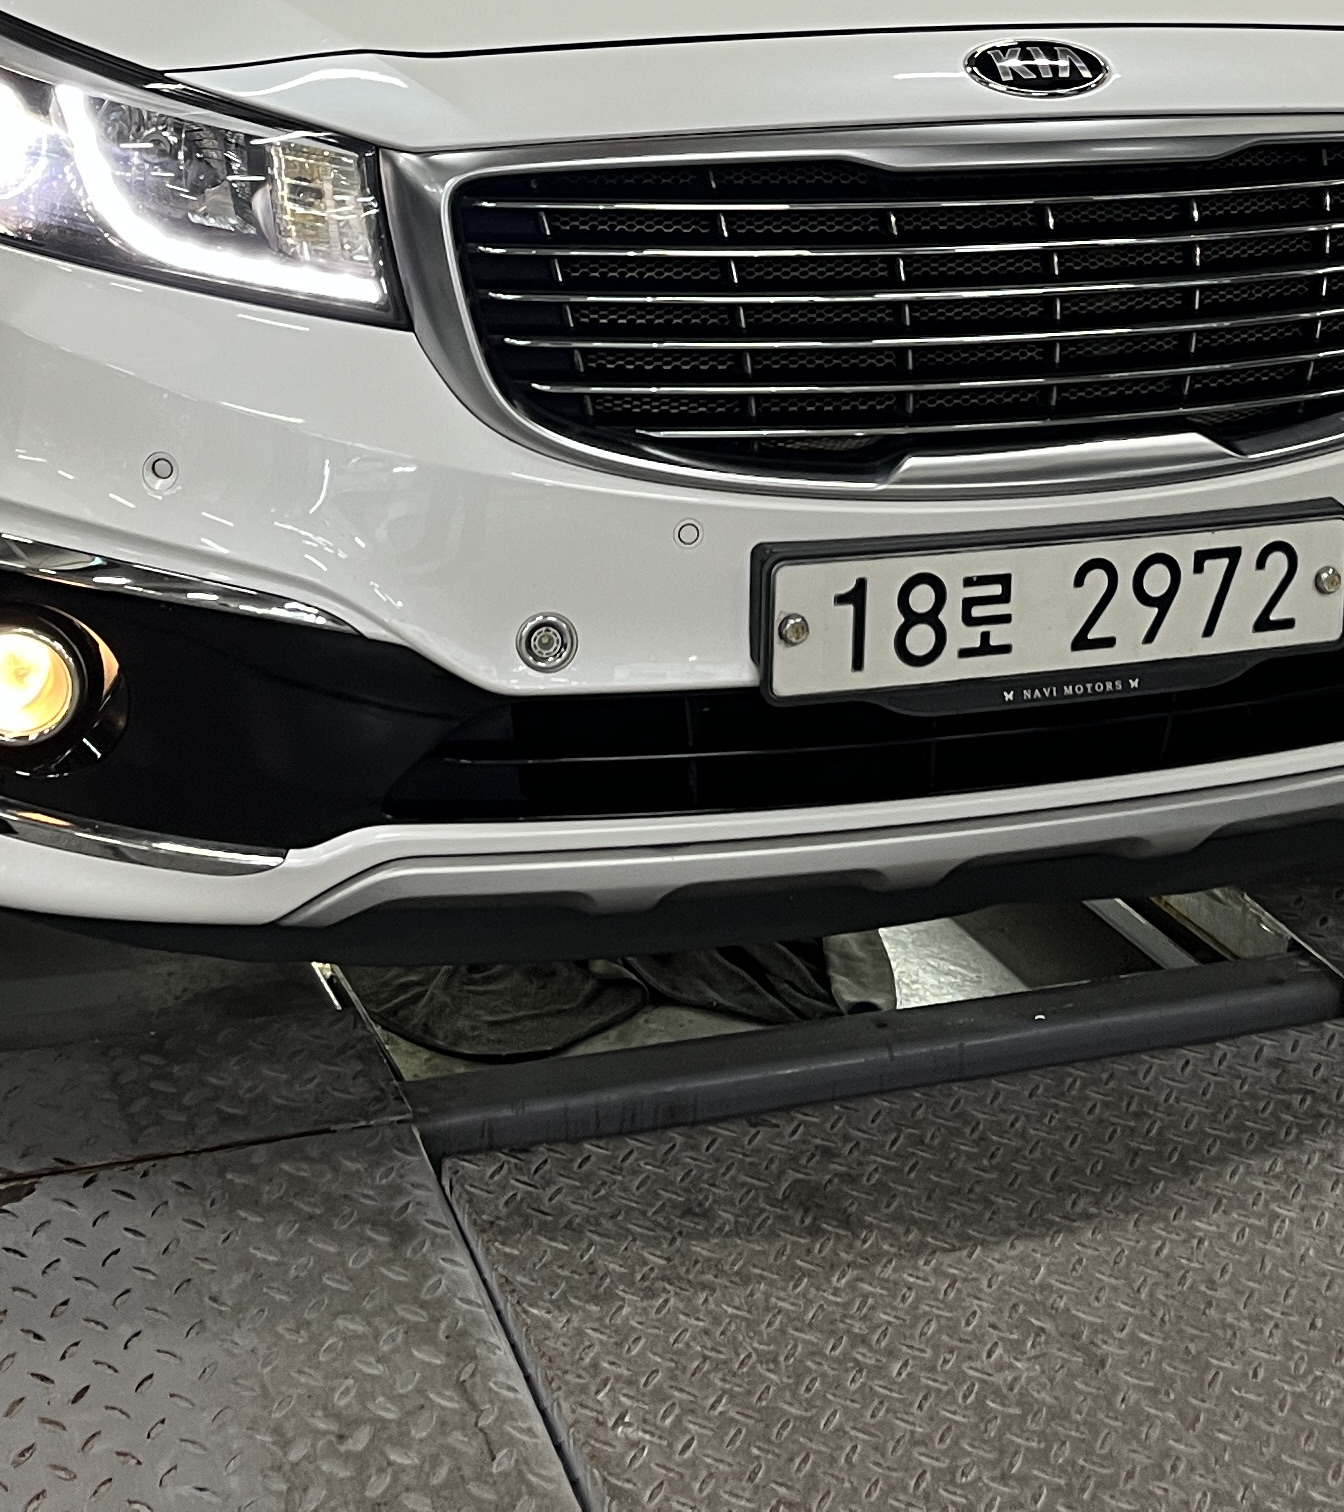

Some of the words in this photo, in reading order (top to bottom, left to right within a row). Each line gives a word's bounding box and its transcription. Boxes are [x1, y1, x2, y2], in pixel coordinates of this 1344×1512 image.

[987, 46, 1093, 82] KIA
[833, 572, 1013, 673] 18로
[1070, 540, 1299, 652] 2972
[1022, 686, 1057, 700] NAVI
[1063, 680, 1123, 696] MOTORS
